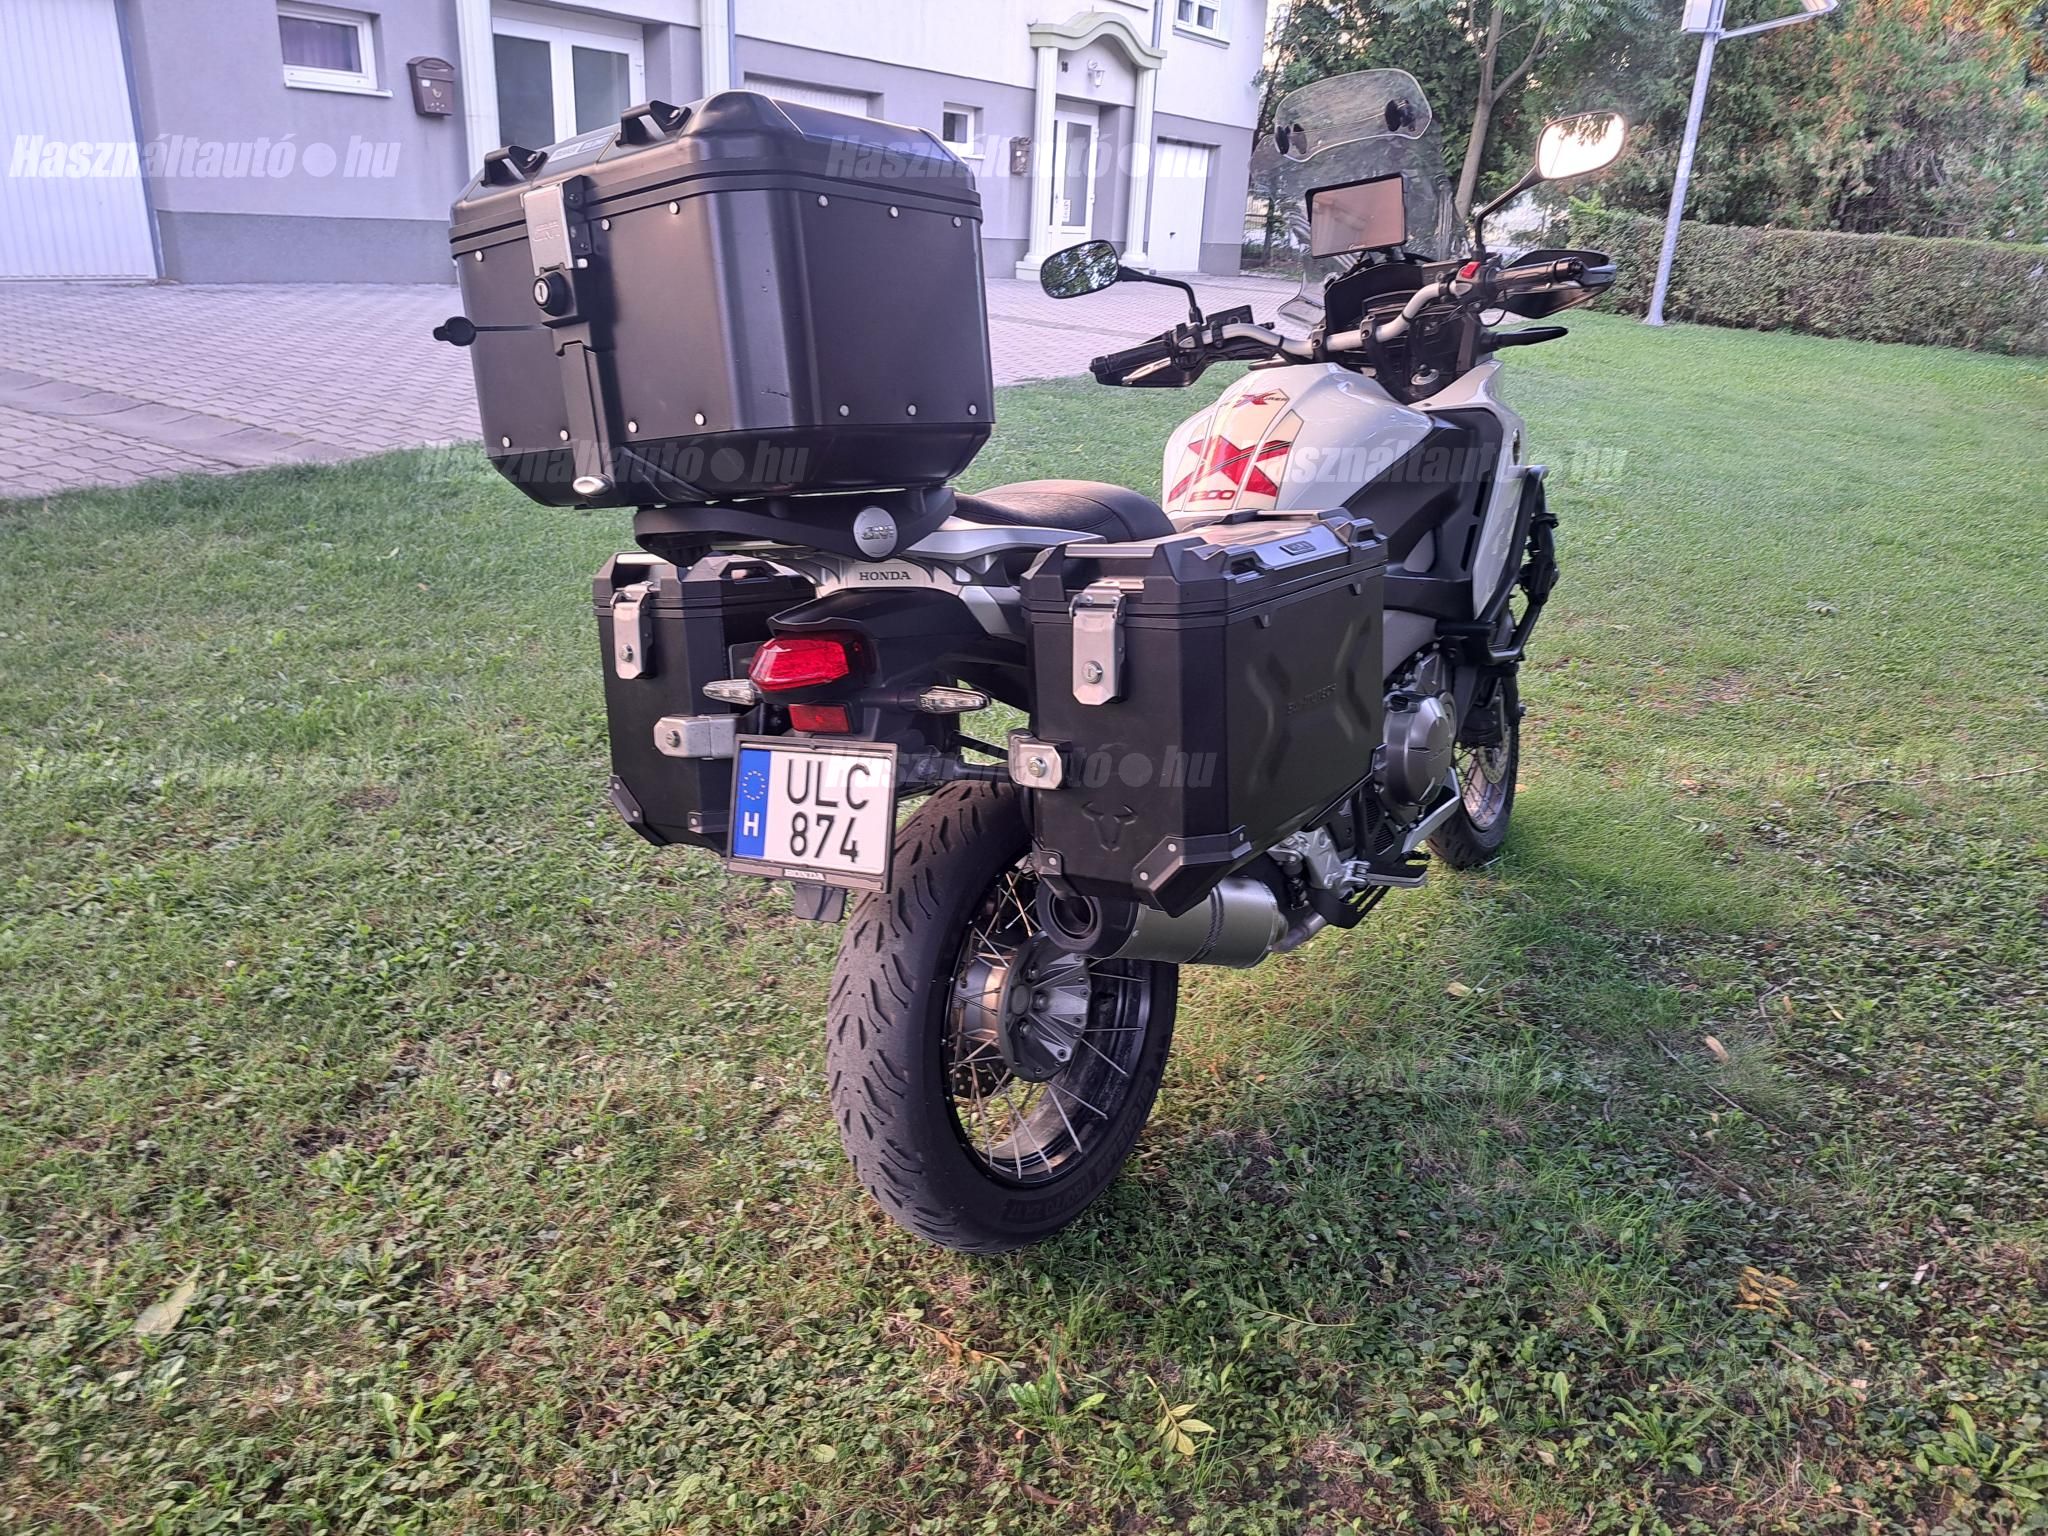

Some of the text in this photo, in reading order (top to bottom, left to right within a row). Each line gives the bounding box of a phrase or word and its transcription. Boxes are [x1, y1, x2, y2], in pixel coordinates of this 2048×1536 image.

[859, 571, 912, 581] HONDA
[786, 759, 871, 811] ULC
[742, 811, 759, 838] H
[789, 812, 859, 863] 874
